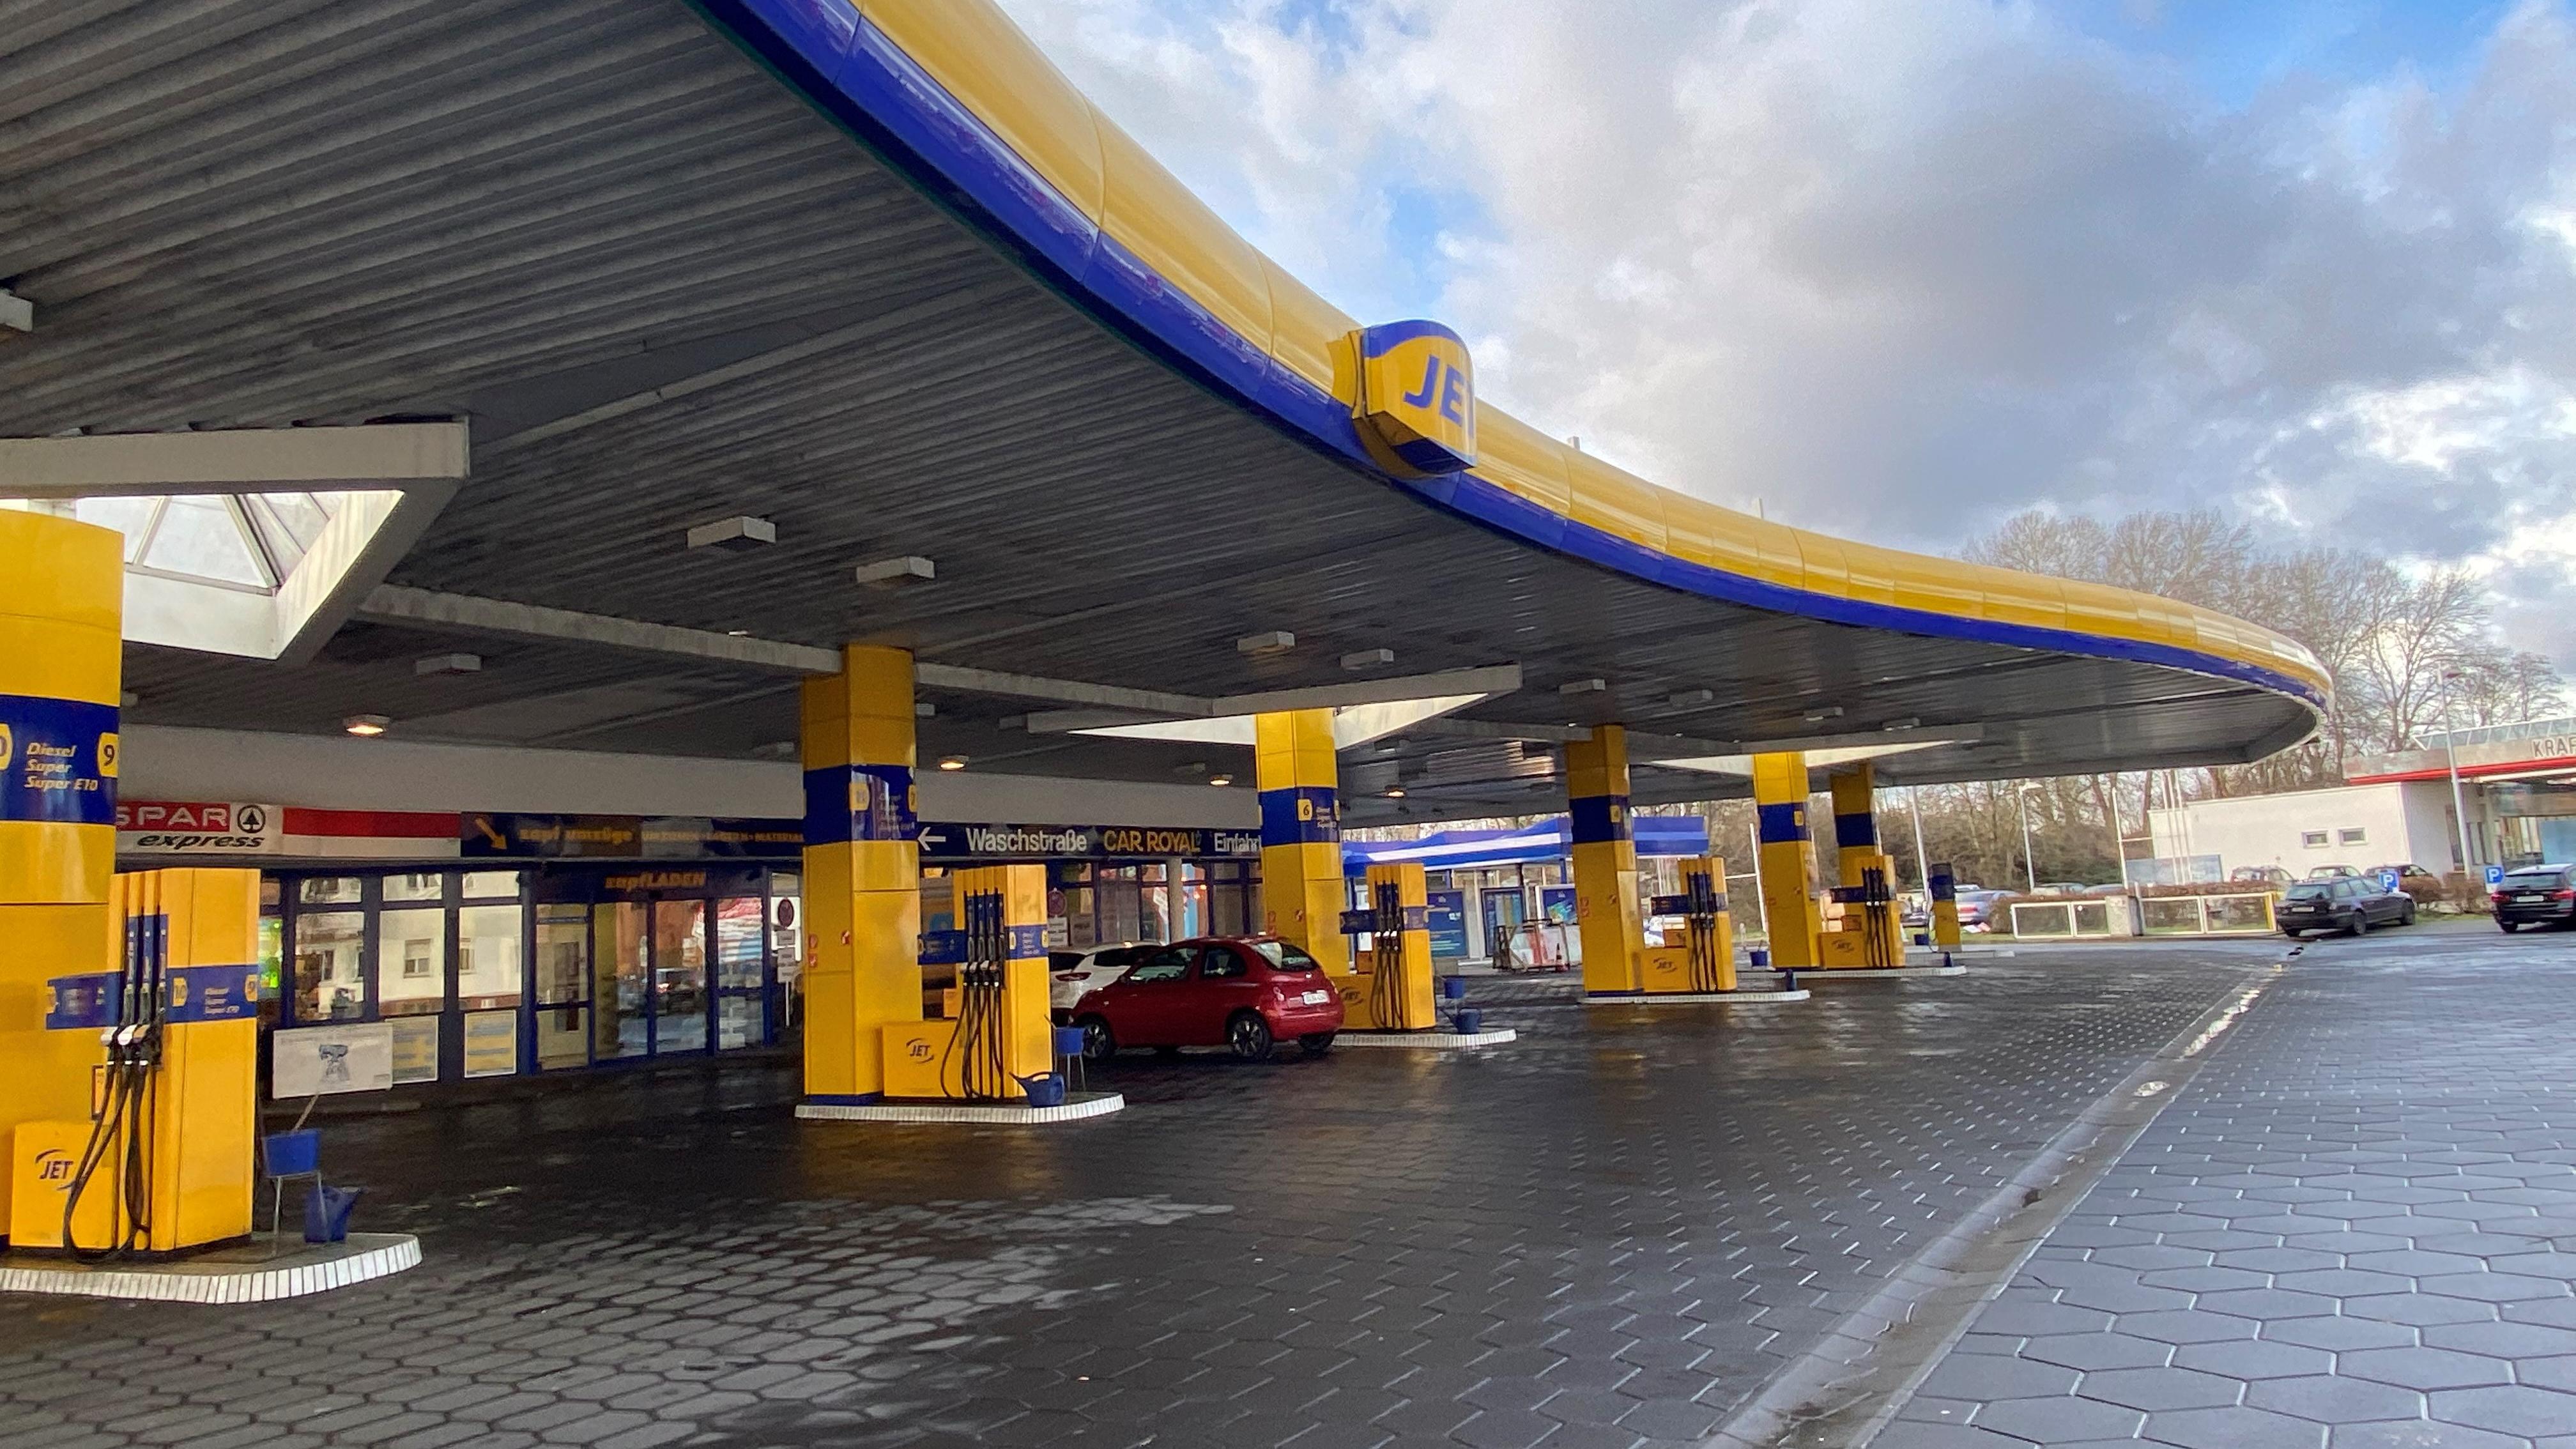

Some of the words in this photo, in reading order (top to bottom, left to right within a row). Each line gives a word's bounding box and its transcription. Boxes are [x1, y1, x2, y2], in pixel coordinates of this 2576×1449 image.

[27, 742, 77, 757] Diesel
[103, 744, 114, 766] 9
[25, 758, 72, 776] Super
[24, 776, 71, 792] Super
[73, 778, 98, 791] E10
[116, 806, 227, 827] SPAR
[1303, 804, 1310, 816] 6
[137, 835, 265, 850] express
[965, 827, 1087, 852] Waschstraße
[1104, 831, 1144, 852] CAR
[1147, 831, 1200, 852] ROYAL
[2382, 874, 2394, 887] P
[2488, 868, 2499, 882] P
[909, 1045, 931, 1057] JET
[39, 1160, 73, 1180] JET
